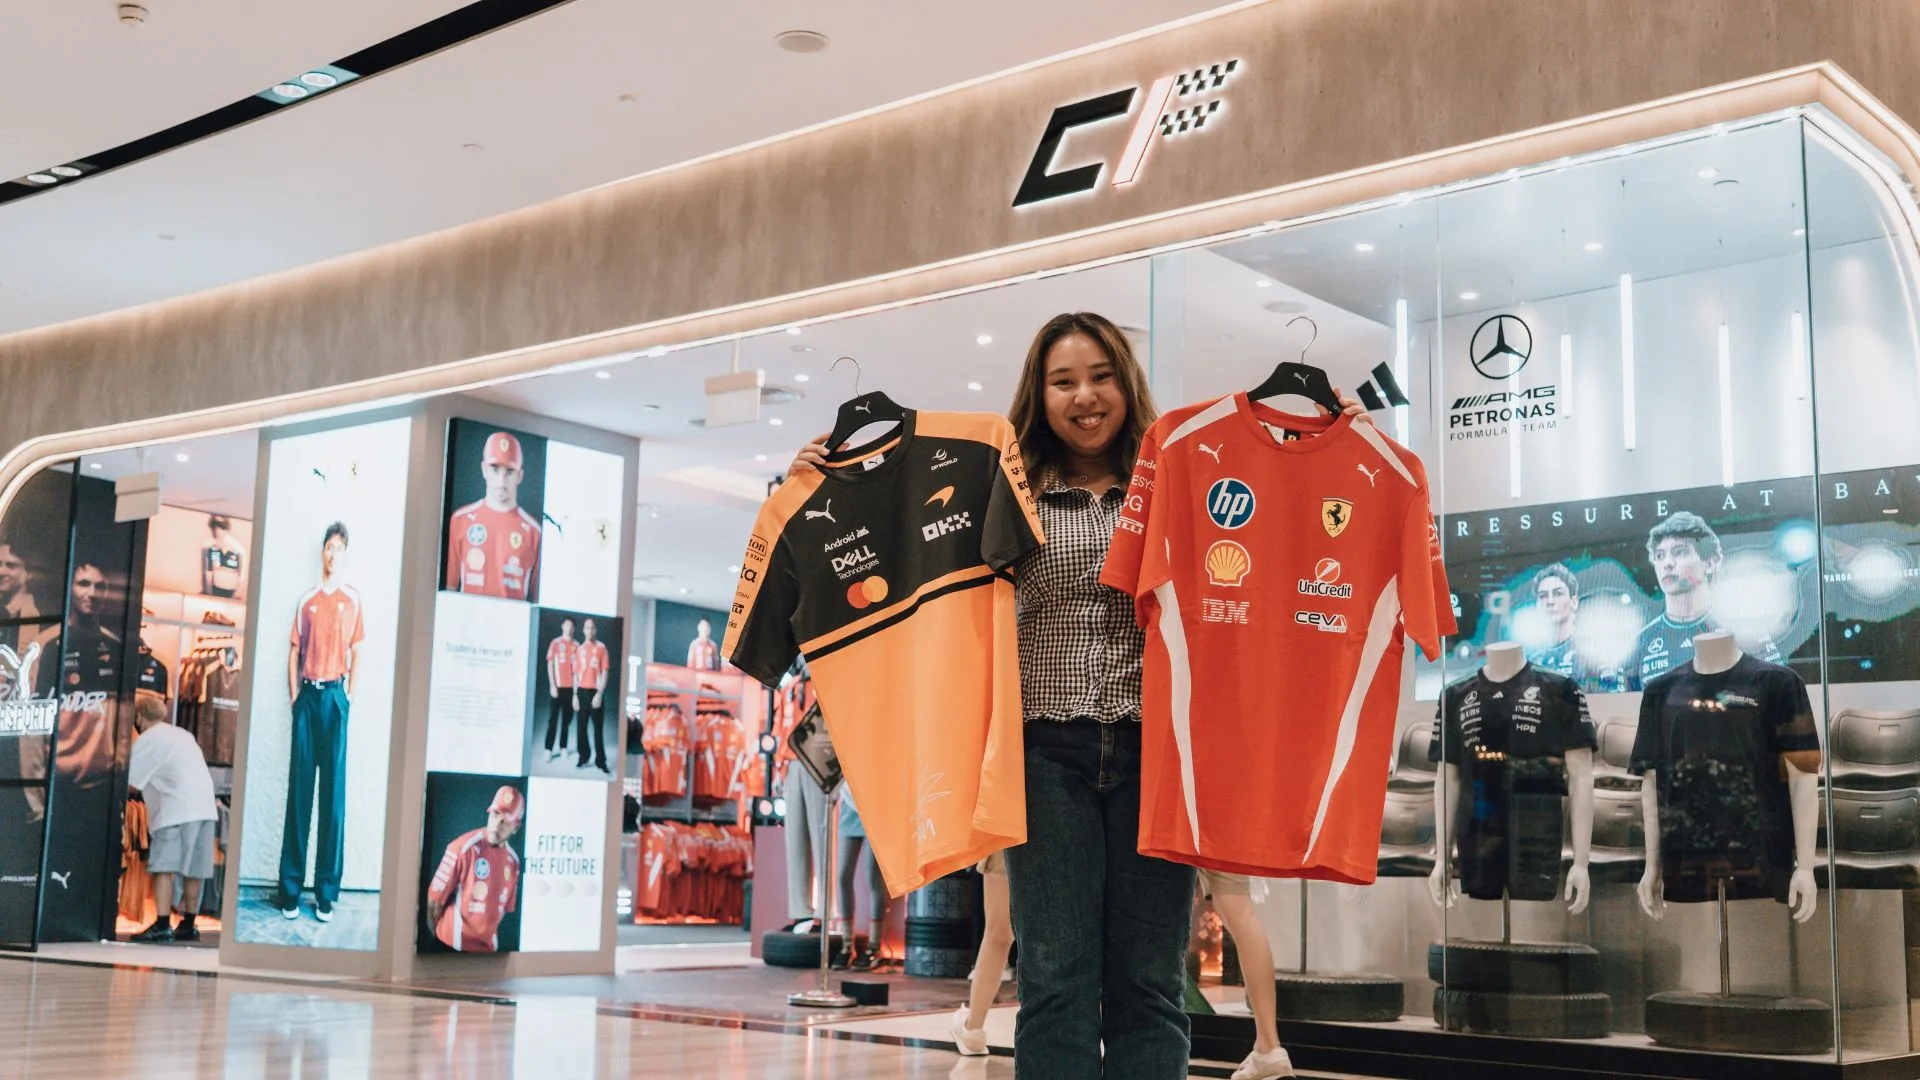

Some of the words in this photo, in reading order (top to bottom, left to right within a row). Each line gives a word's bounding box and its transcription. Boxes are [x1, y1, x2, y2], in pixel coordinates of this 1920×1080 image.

[1485, 385, 1556, 406] AMG
[1450, 402, 1556, 429] PETRONAS
[1450, 426, 1508, 441] FORMULA
[1523, 420, 1557, 432] TEAM
[1721, 489, 1774, 510] AT
[1834, 474, 1920, 500] BA
[1212, 480, 1250, 528] hp
[921, 511, 972, 542] OKX
[824, 532, 856, 553] Android
[831, 545, 877, 573] DELL
[837, 559, 880, 580] Technologies
[1299, 580, 1352, 598] UniCredit
[1202, 598, 1250, 625] IBM
[1515, 705, 1541, 716] INEOS
[1516, 723, 1537, 734] HPE
[538, 835, 556, 852] FIT
[560, 836, 584, 853] FOR
[550, 858, 597, 876] FUTURE
